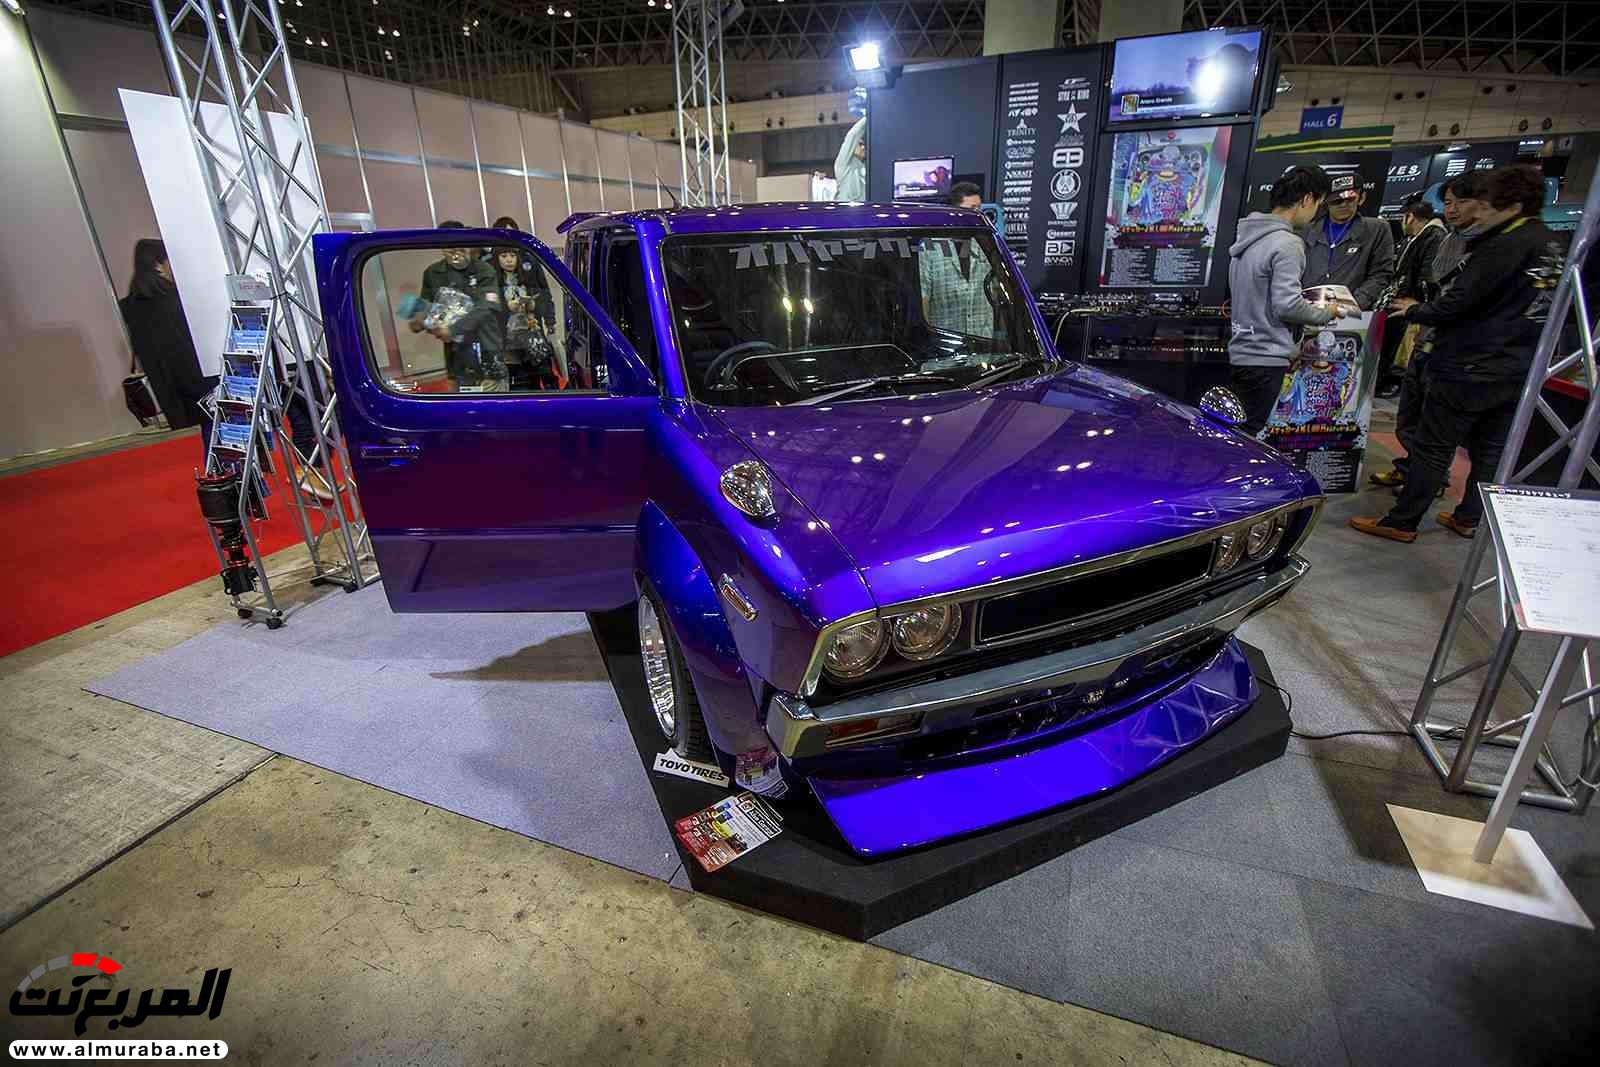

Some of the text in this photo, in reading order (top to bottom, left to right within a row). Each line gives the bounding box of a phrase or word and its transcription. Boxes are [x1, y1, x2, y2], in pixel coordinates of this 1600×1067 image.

[1303, 113, 1338, 129] HALL 6
[659, 758, 691, 773] TOYO
[689, 766, 727, 782] TIRES
